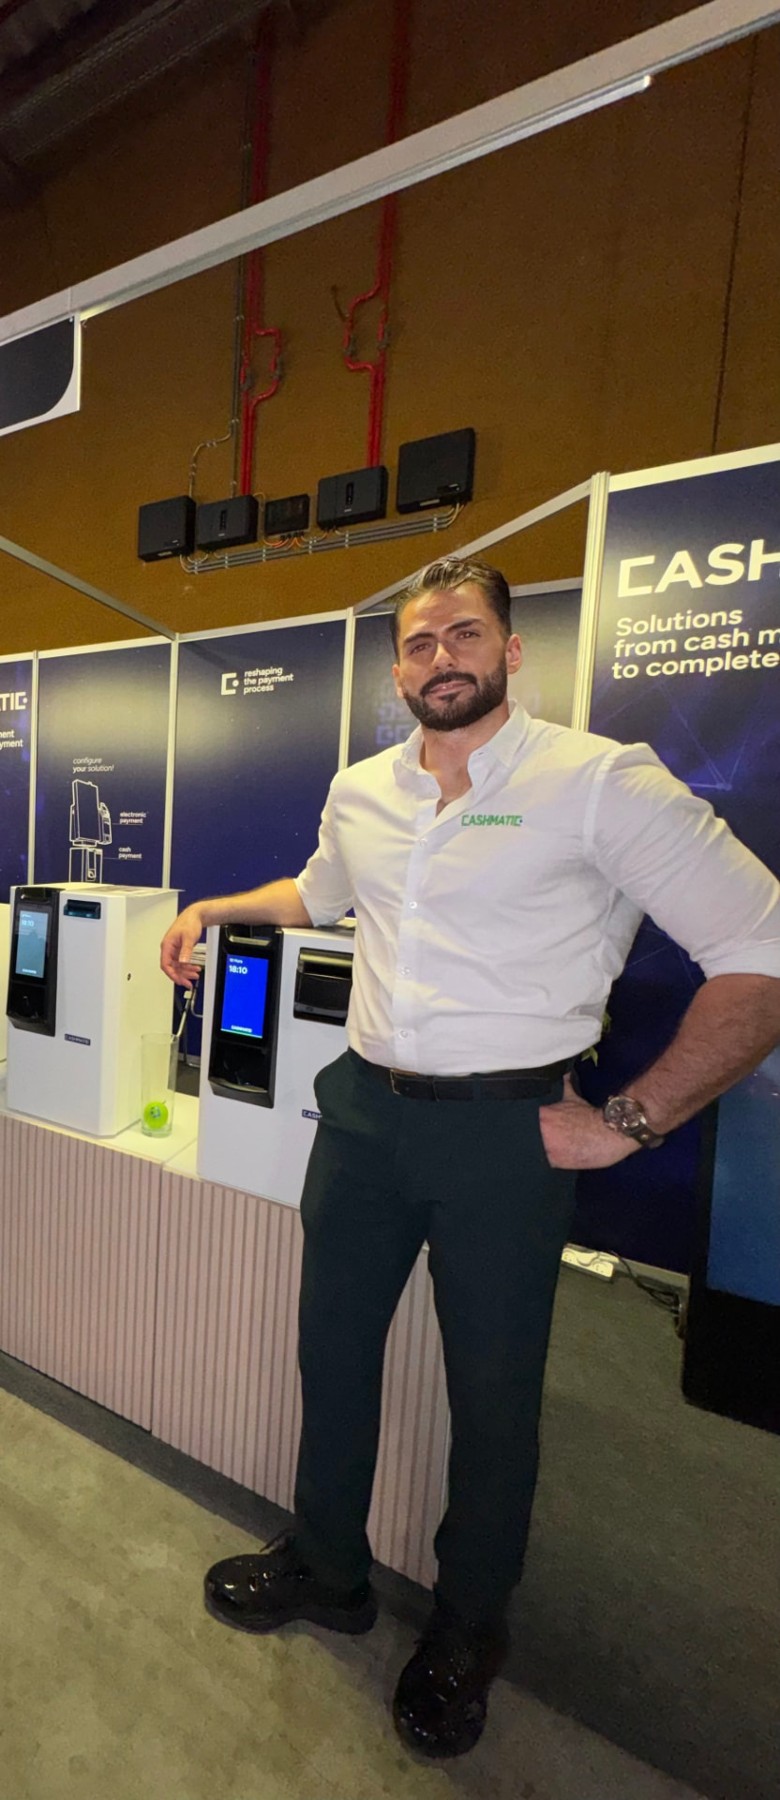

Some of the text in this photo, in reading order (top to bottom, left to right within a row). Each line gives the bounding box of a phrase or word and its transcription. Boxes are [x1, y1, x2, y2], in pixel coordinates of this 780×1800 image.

[616, 609, 743, 637] Solutions
[614, 639, 677, 658] from
[684, 628, 750, 652] cash
[612, 650, 780, 680] to complete
[244, 666, 283, 678] reshaping
[243, 673, 294, 686] the payment
[243, 684, 275, 695] process
[0, 691, 28, 711] TIC
[72, 757, 103, 766] configure
[72, 766, 86, 774] your
[461, 814, 523, 827] CASHMATIC
[229, 965, 248, 975] 18:10
